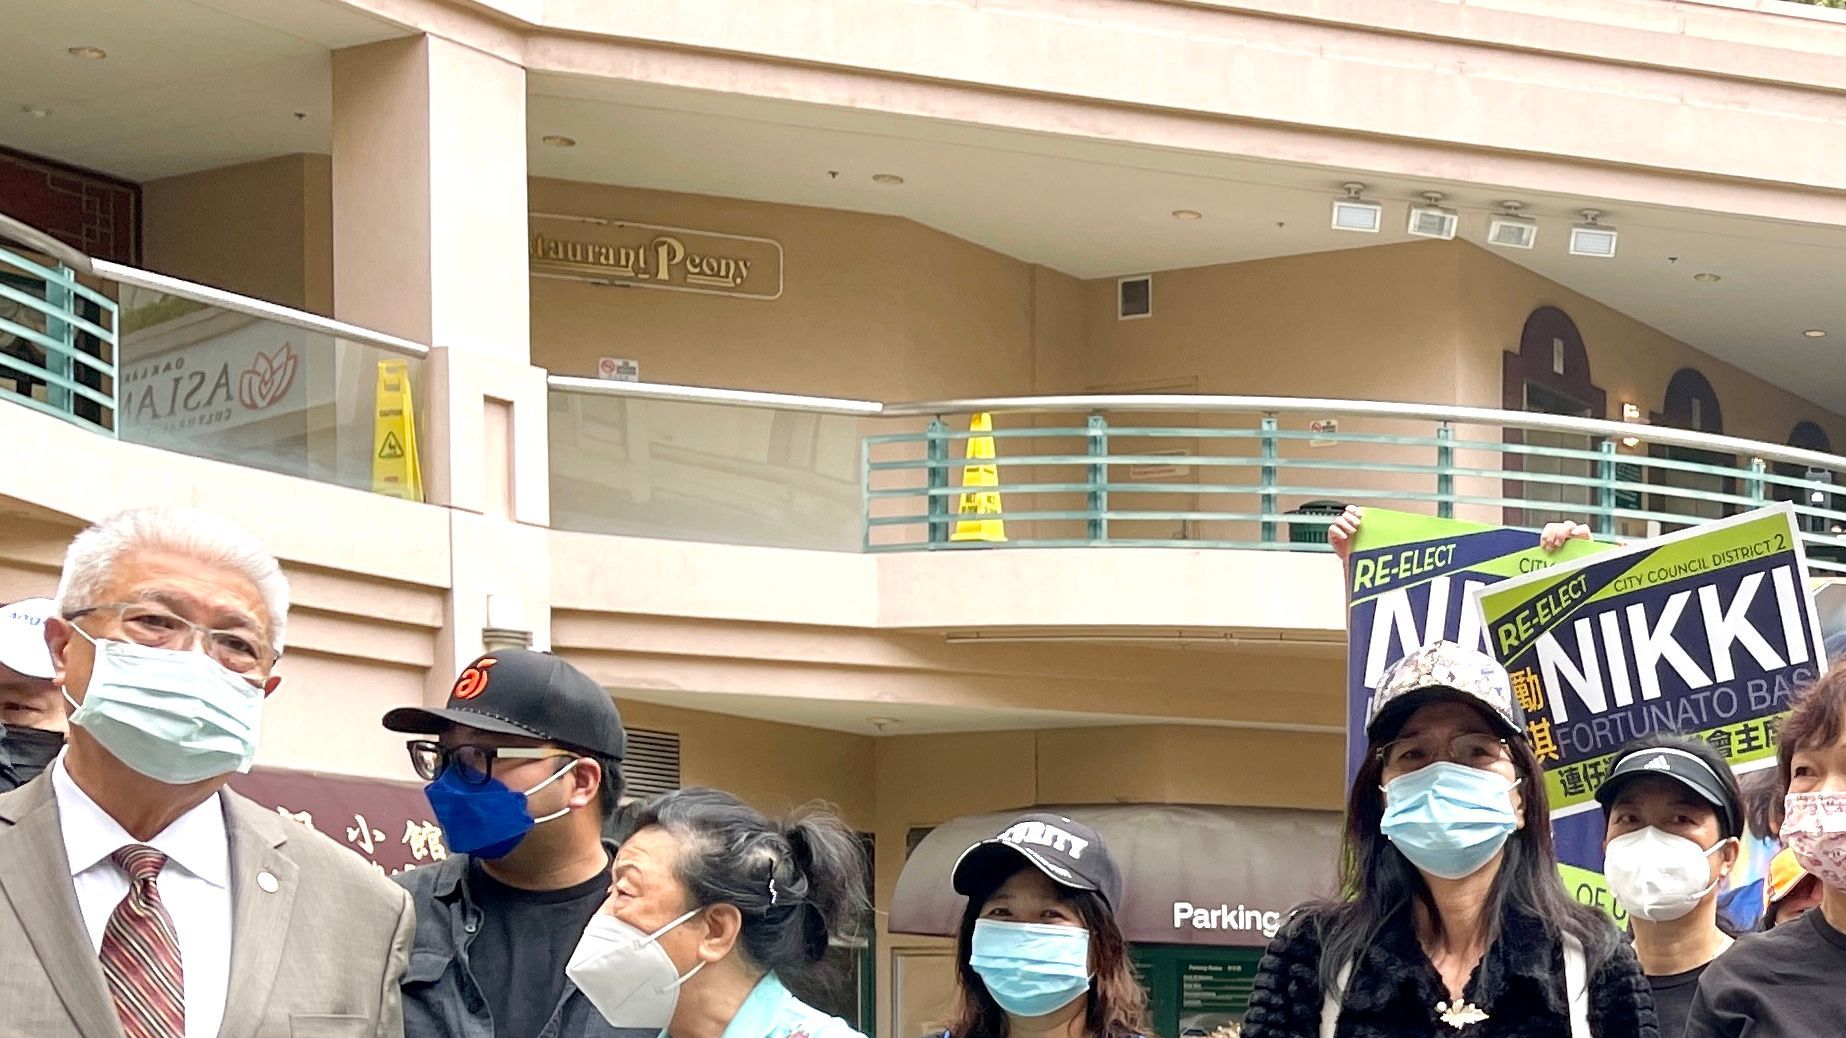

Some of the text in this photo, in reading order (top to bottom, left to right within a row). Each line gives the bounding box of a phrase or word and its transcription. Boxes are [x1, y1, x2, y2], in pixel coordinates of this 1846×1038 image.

[532, 232, 751, 287] taurant Peony
[1353, 543, 1457, 593] RE-ELECT
[1613, 533, 1787, 594] CITY COUNCIL DISTRICT 2
[1497, 574, 1588, 656] RE-ELECT
[1535, 564, 1810, 725] NIKKI
[1555, 668, 1812, 759] FORTUNATO BAS
[1173, 901, 1281, 938] Parking
[1577, 883, 1629, 921] OF U
